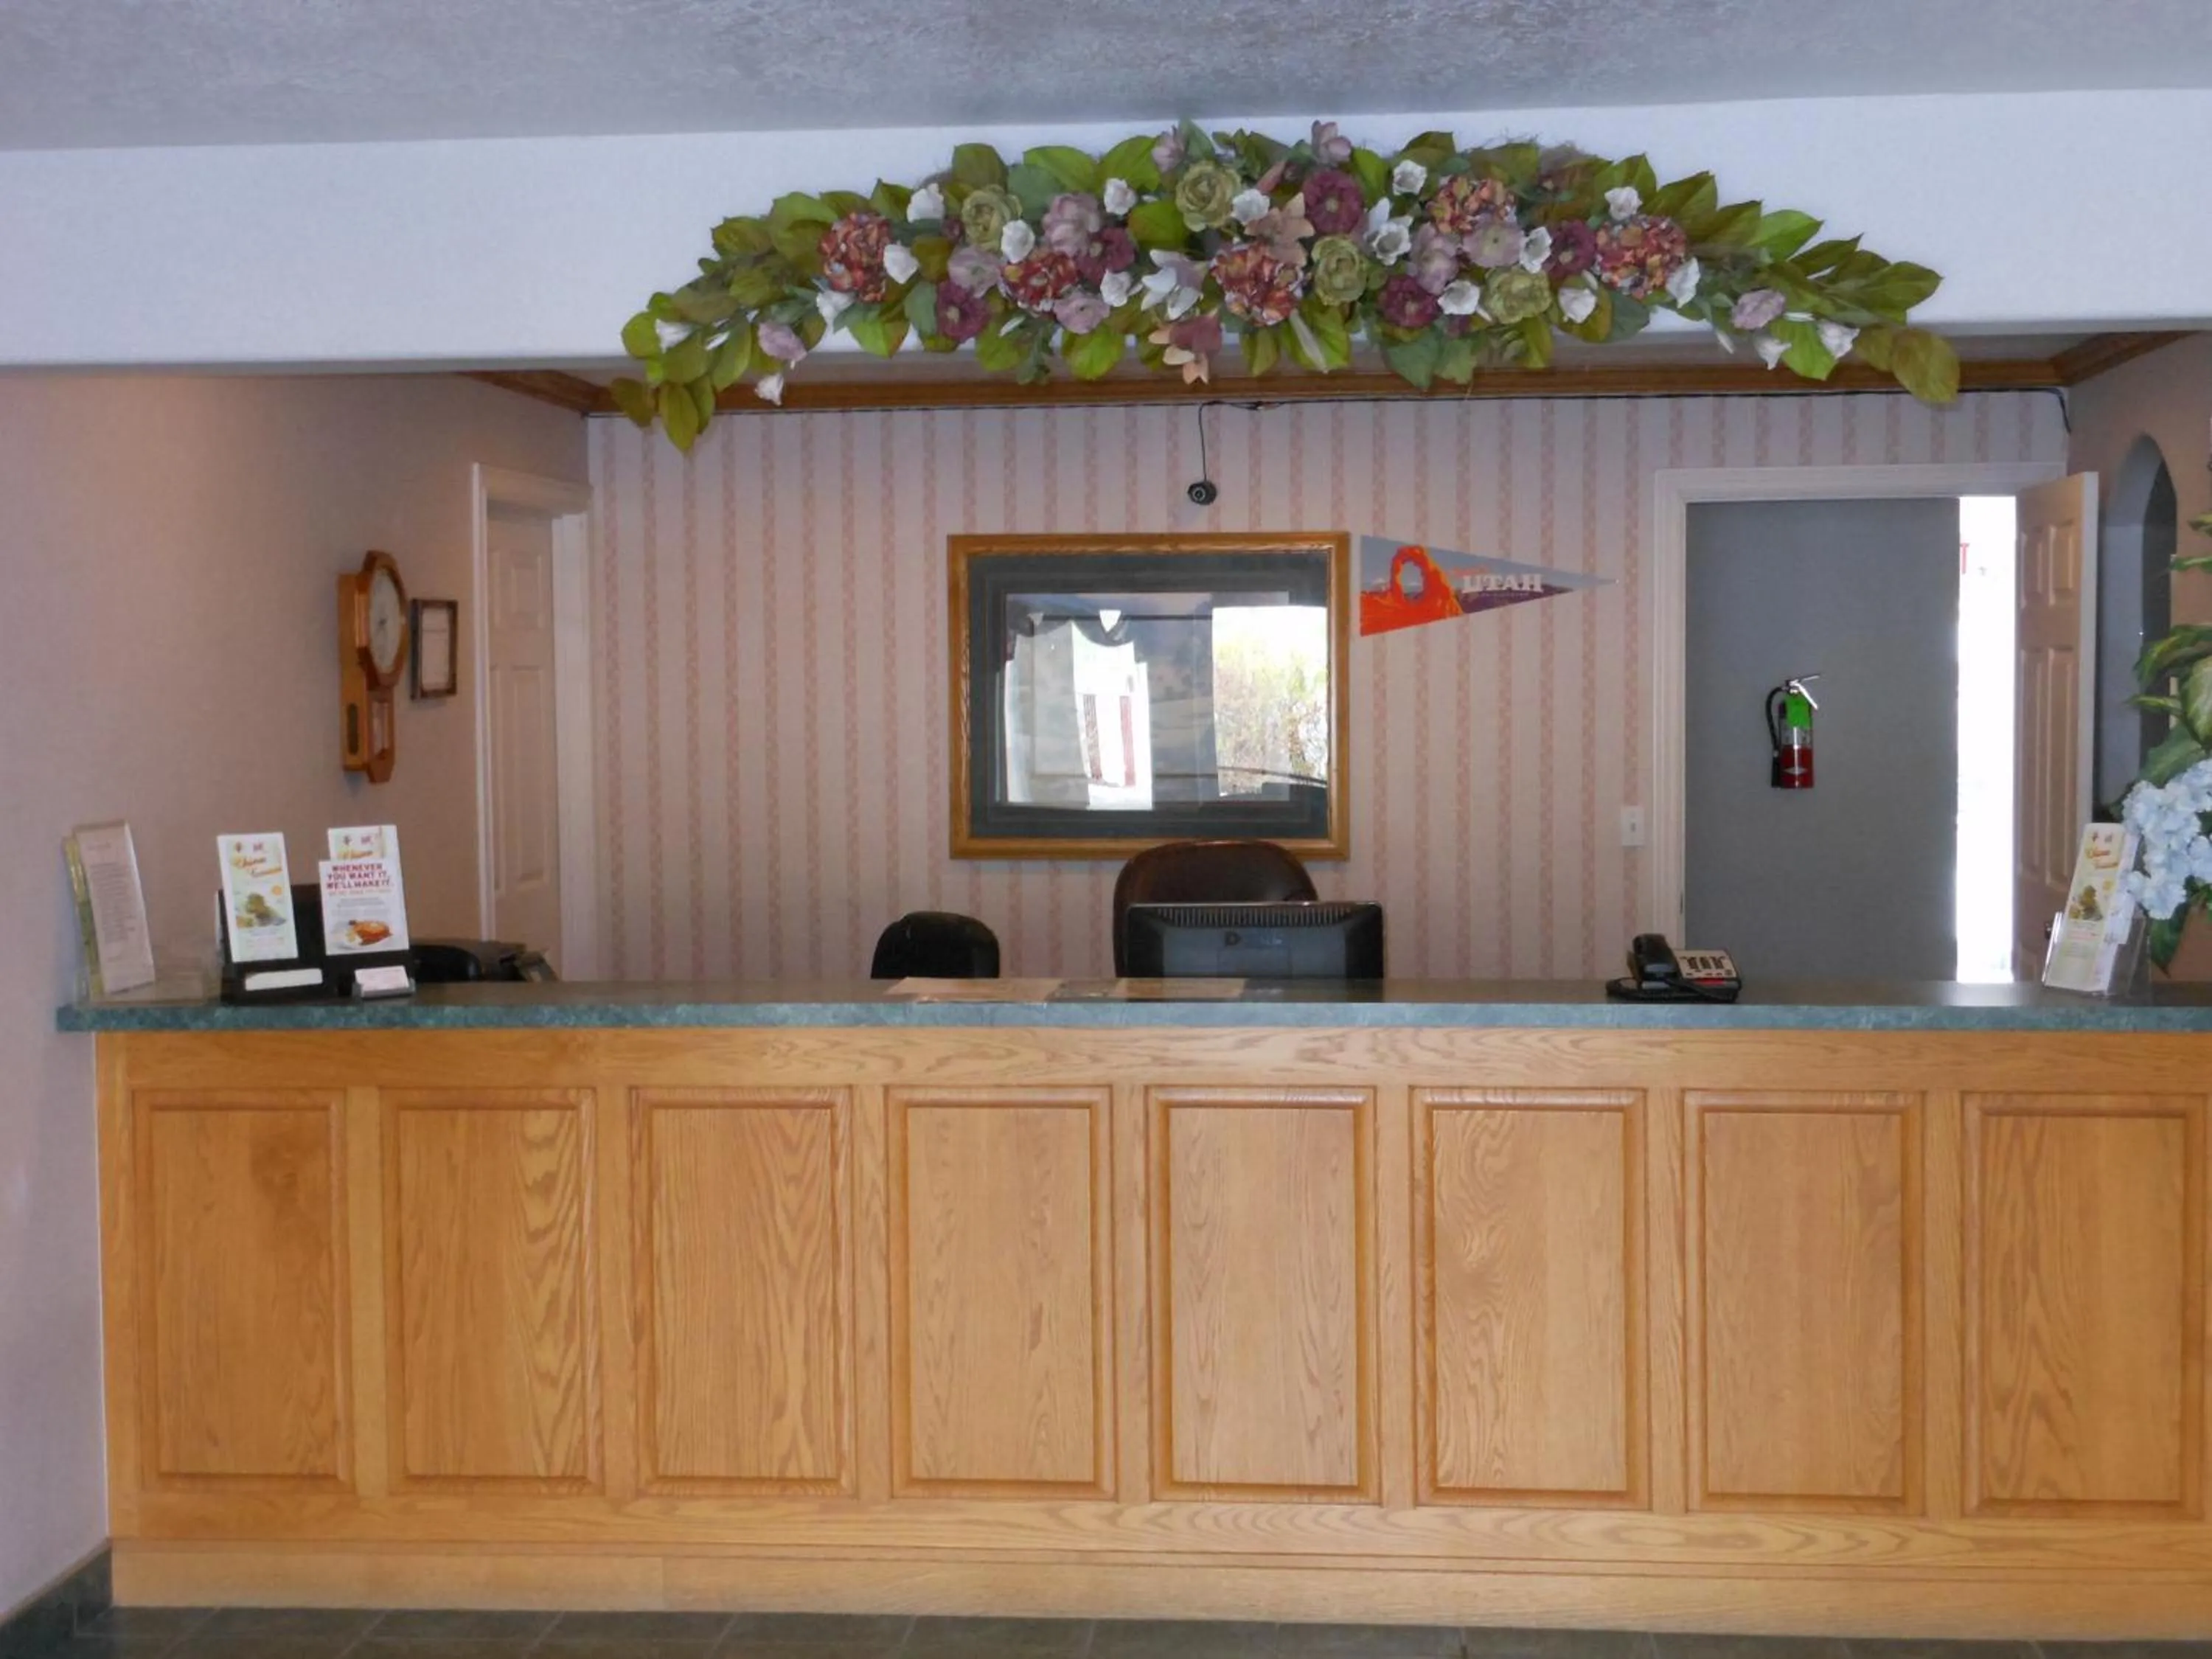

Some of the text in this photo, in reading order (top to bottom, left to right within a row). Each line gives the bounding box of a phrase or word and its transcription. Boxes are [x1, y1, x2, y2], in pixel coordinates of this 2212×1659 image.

[1461, 573, 1544, 594] UTAH
[332, 862, 383, 872] WHENEVER
[327, 872, 347, 880] YOU
[349, 872, 375, 880] WANT
[354, 879, 380, 888] MAKE
